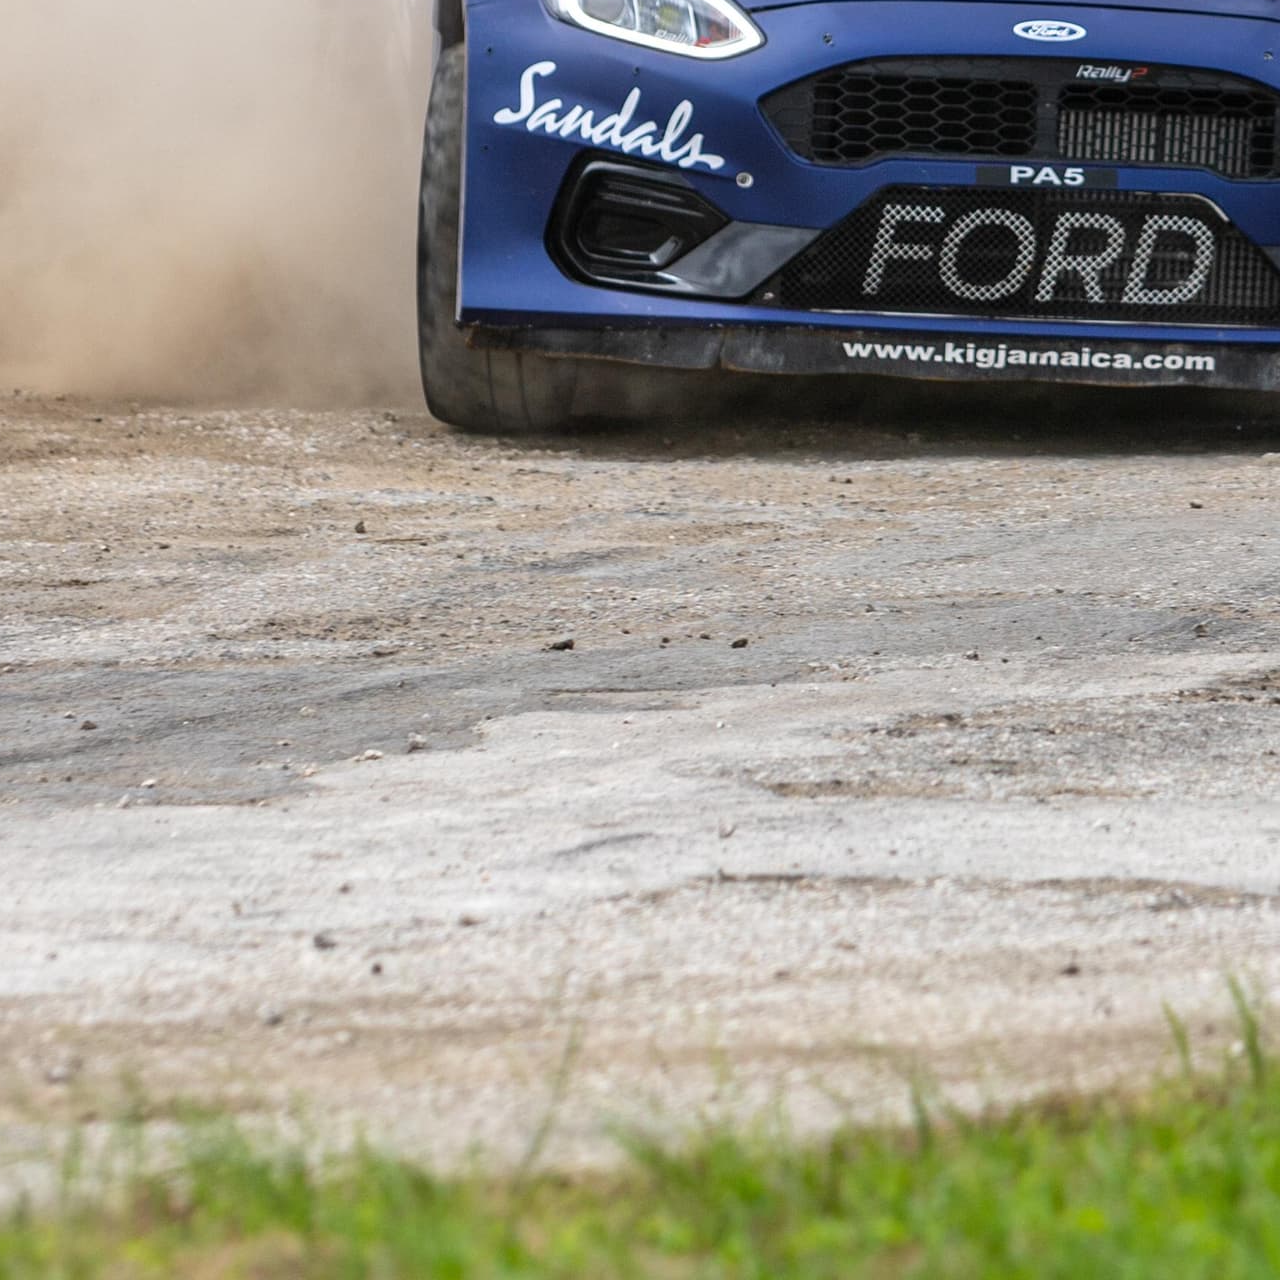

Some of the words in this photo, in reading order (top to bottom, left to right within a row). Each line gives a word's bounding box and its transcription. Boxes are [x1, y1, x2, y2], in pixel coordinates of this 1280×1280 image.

[493, 60, 725, 170] Sandals
[1009, 165, 1085, 186] PA5
[861, 203, 1216, 305] FORD
[842, 341, 1216, 371] www.kigjamaica.com
